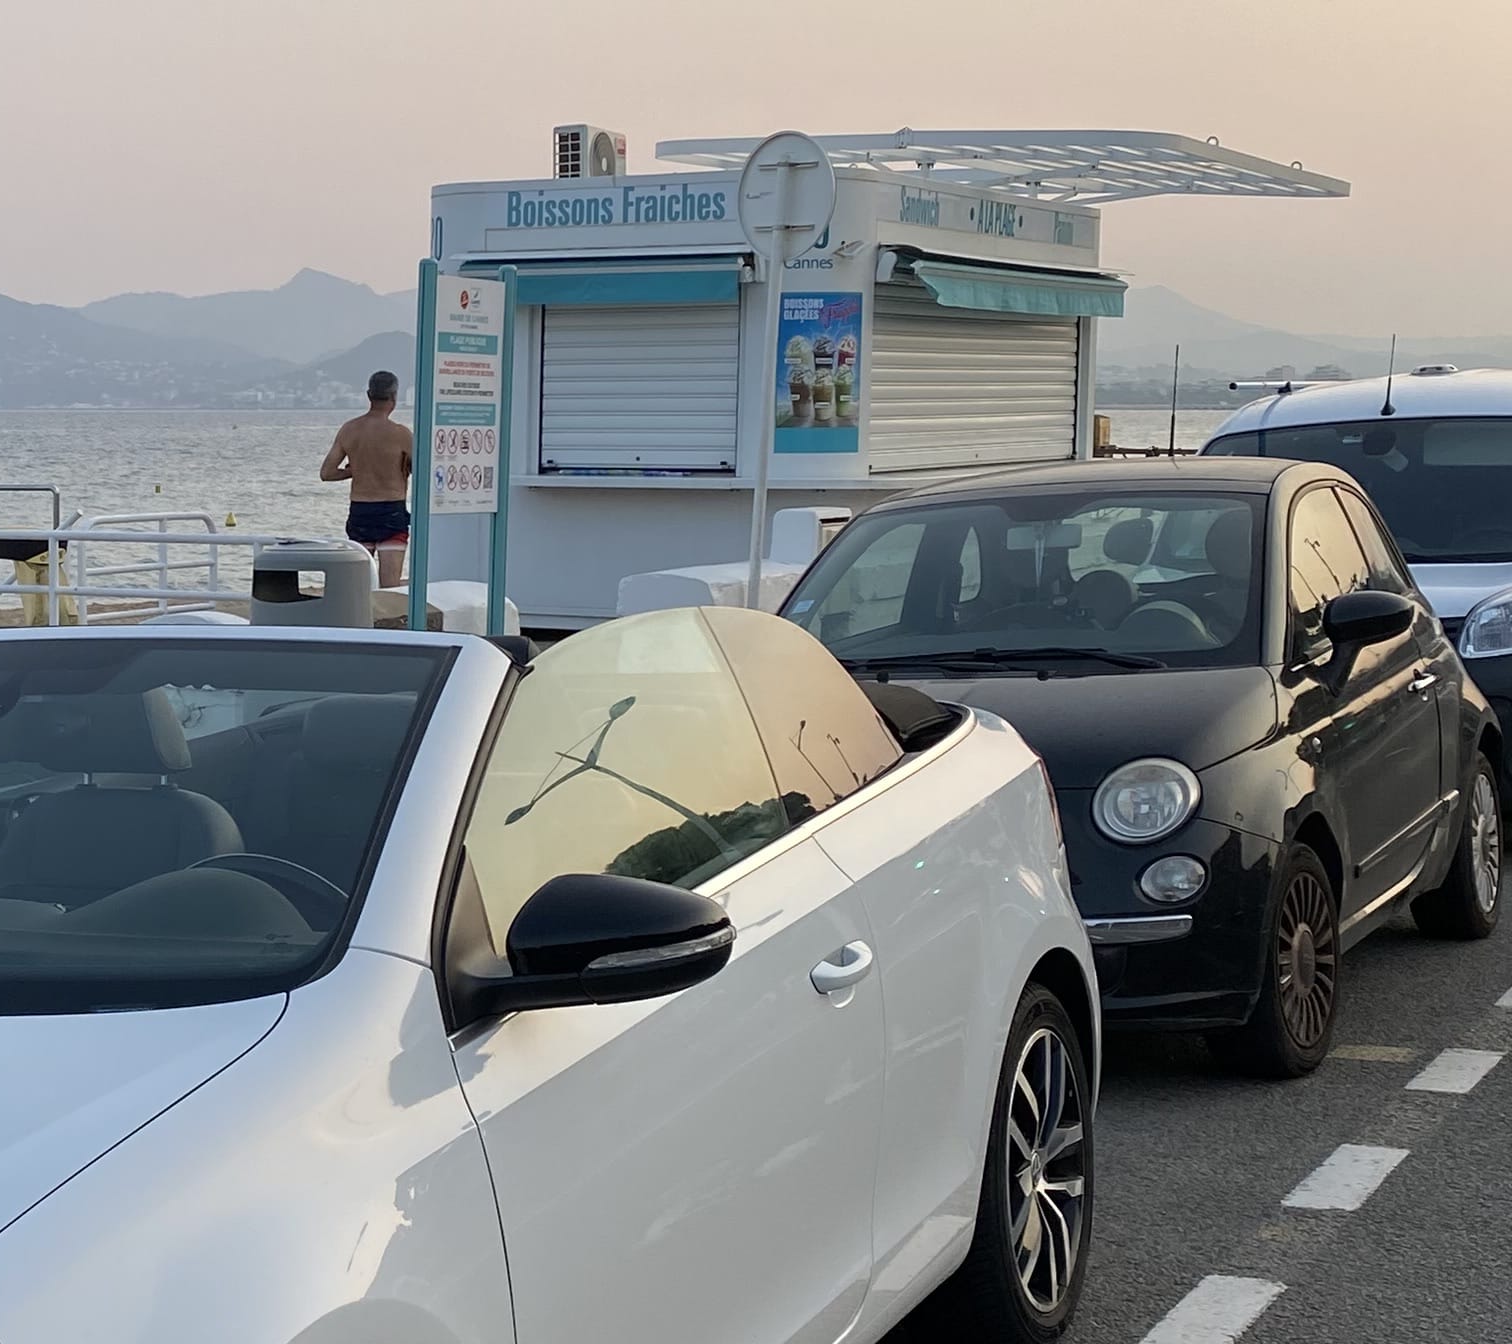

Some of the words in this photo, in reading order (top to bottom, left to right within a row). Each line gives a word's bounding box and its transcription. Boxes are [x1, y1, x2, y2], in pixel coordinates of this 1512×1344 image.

[507, 190, 614, 228] Boissons
[622, 183, 727, 224] Fraiches
[900, 185, 940, 227] Sandwich
[783, 298, 824, 310] BOISSONS
